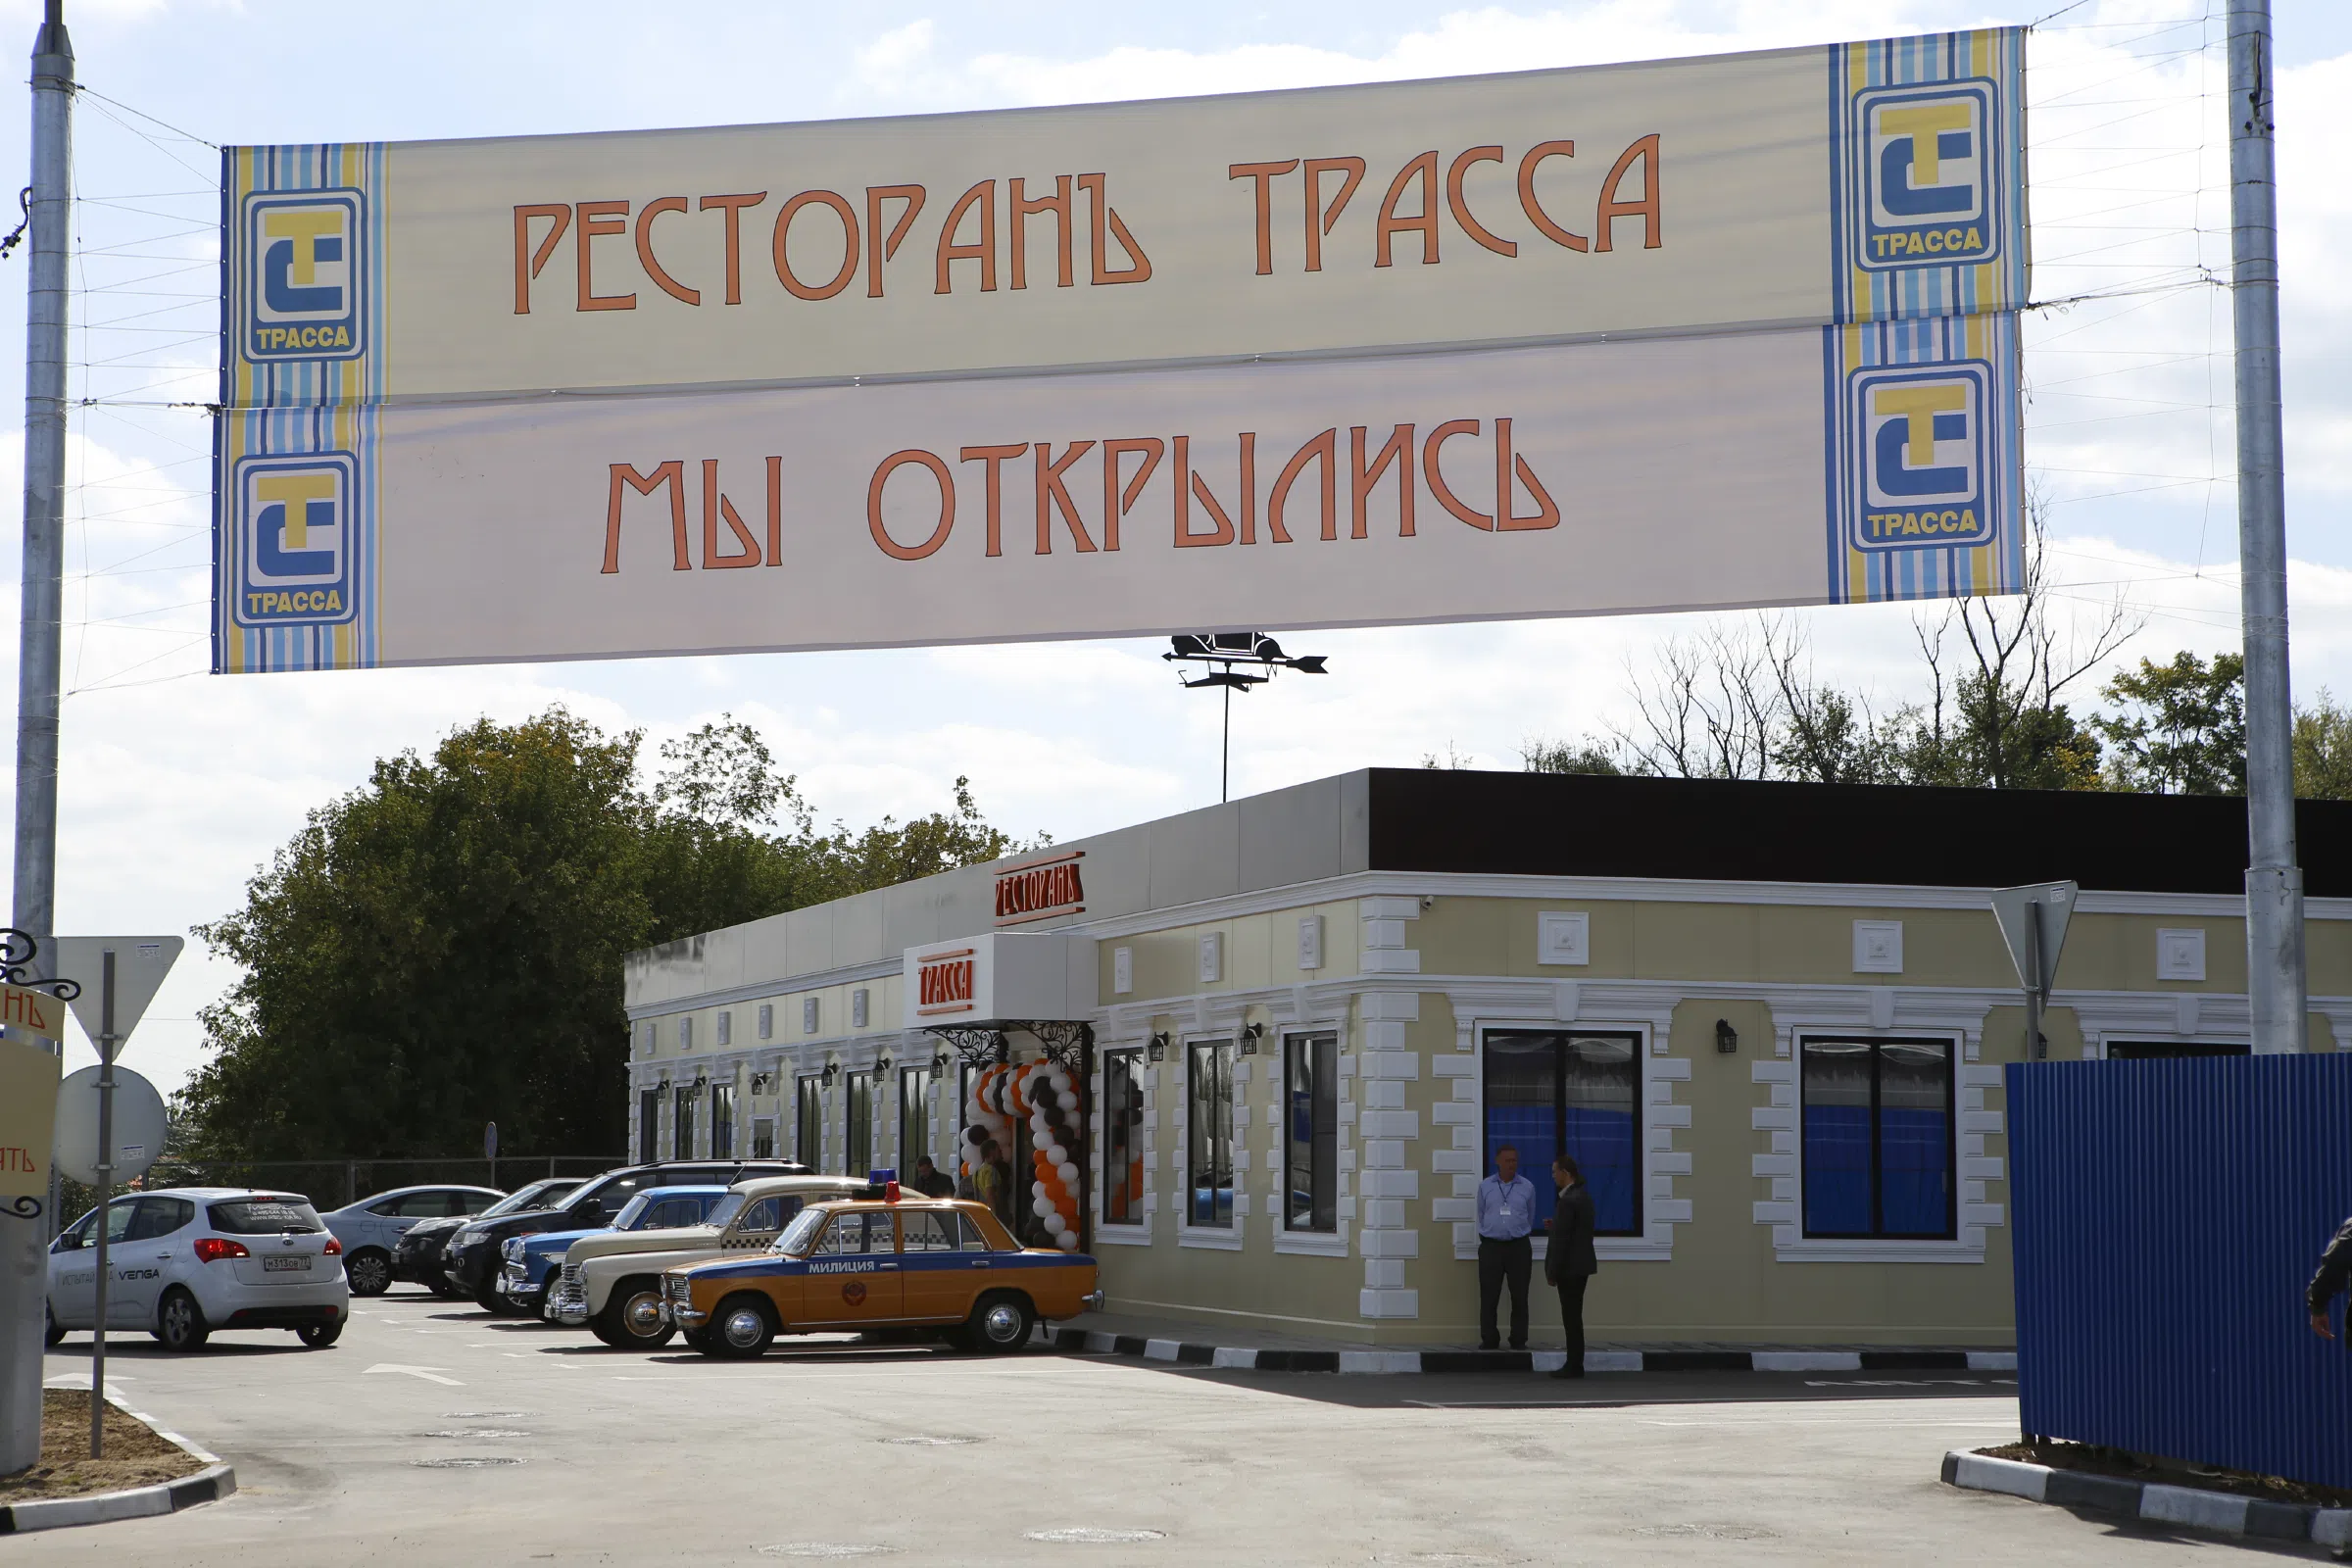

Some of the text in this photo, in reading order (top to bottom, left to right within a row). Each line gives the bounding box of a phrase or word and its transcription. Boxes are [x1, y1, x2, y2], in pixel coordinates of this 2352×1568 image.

[514, 133, 1662, 315] РЕСТОРАНЪ ТРАССА
[1873, 226, 1984, 257] ТРАССА
[256, 325, 350, 350] ТРАССА
[600, 417, 1560, 574] МЫ ОТКРЫЛИСЬ
[1867, 508, 1979, 537] ТРАССА
[248, 590, 342, 614] ТРАССА
[995, 863, 1084, 916] РЕСТОРАНЪ
[917, 959, 973, 1005] ТРАССА
[808, 1260, 875, 1274] МИЛИЦИЯ
